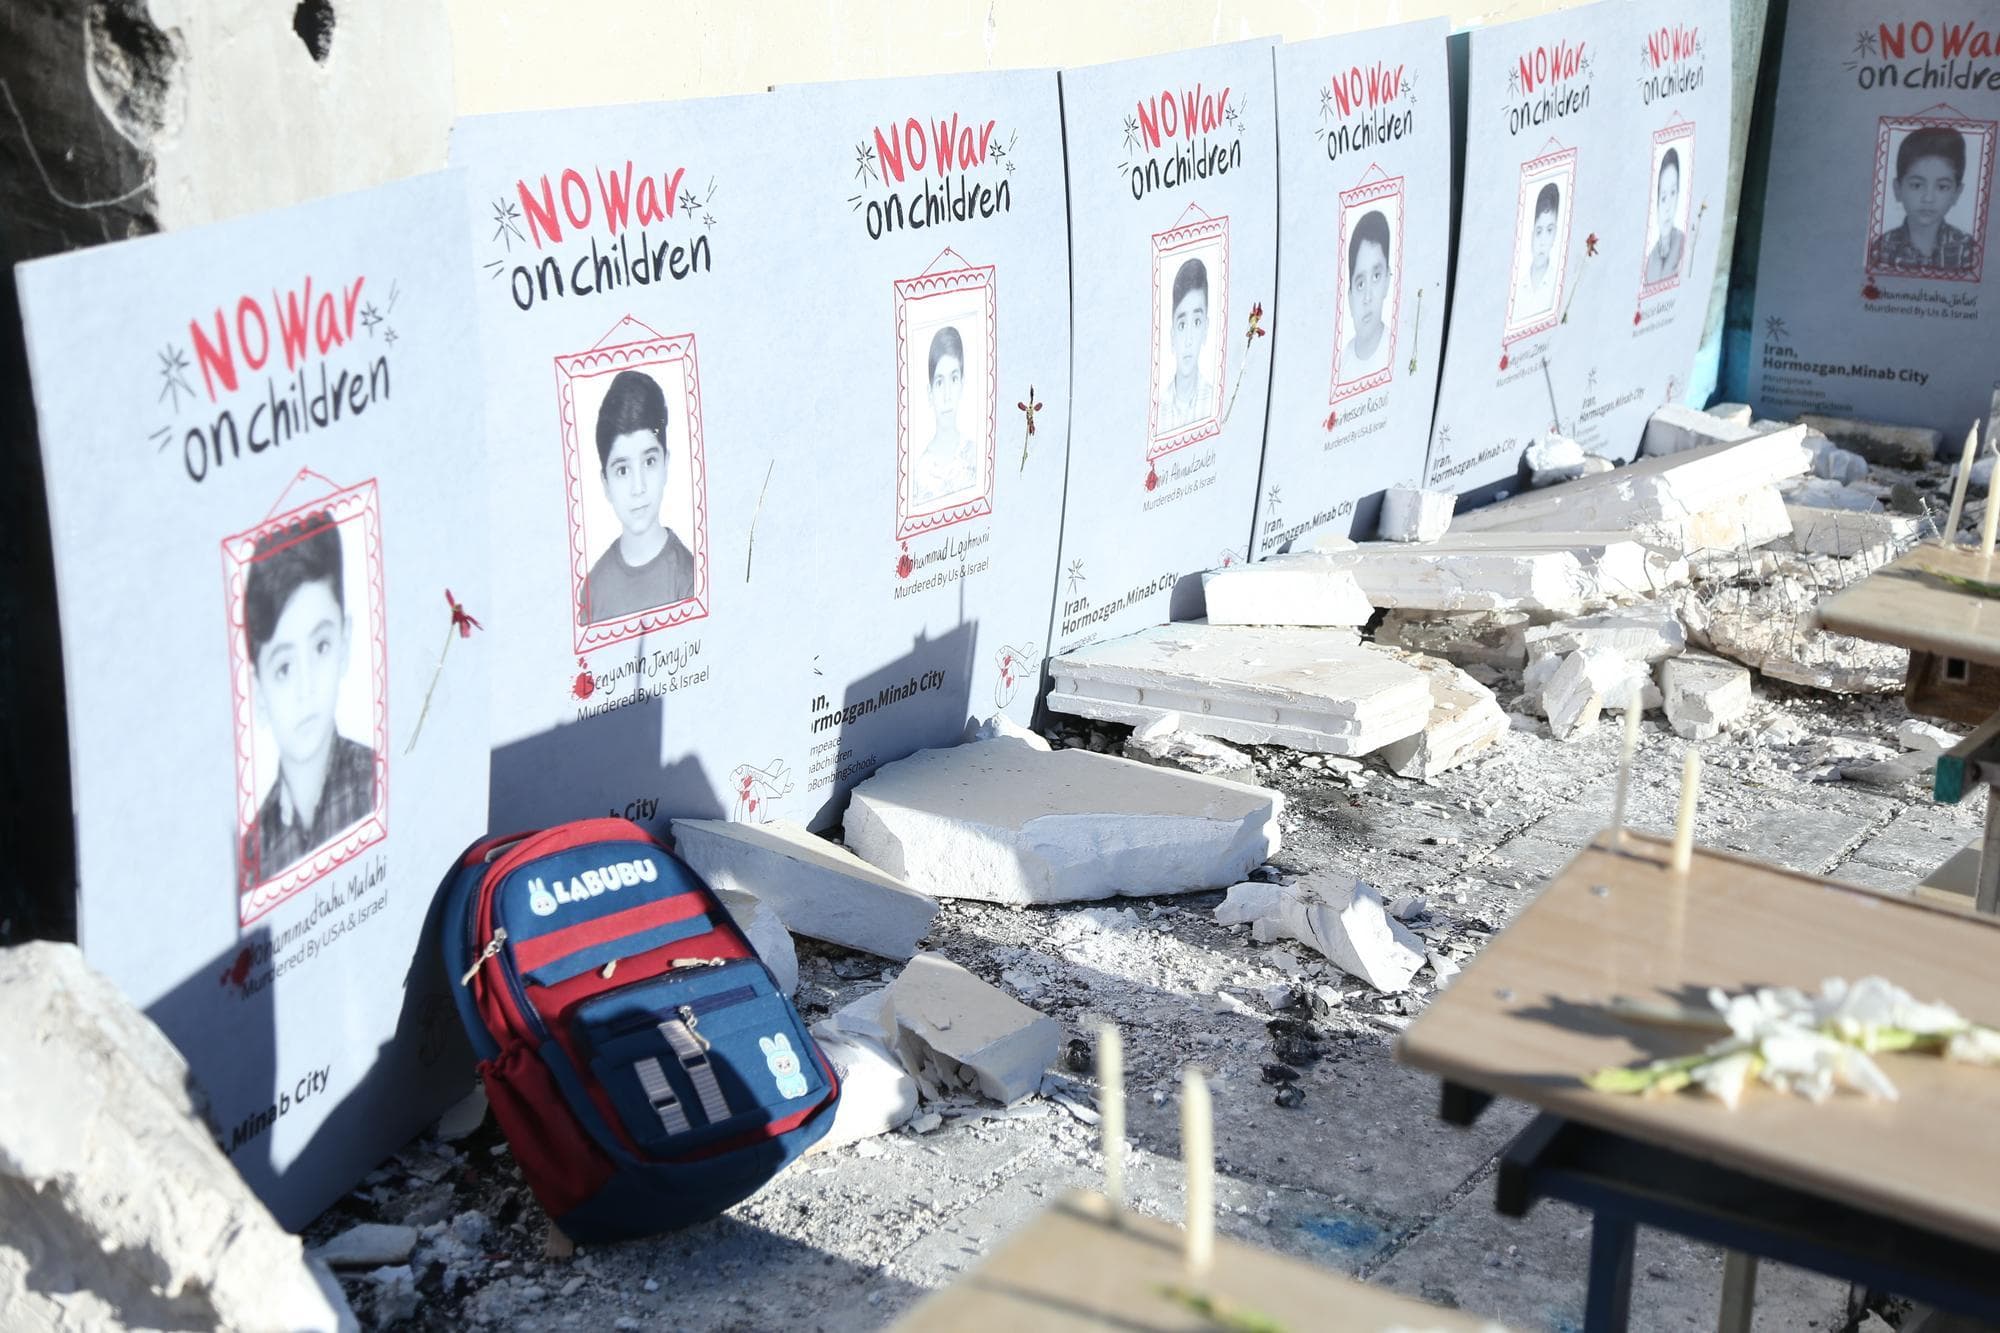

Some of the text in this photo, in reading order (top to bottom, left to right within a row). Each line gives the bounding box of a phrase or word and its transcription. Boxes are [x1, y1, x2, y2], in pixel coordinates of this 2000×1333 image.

[1648, 22, 1698, 72] NO War
[1879, 20, 1934, 60] NO
[1332, 60, 1404, 121] NO War
[1519, 38, 1586, 97] NO War
[1643, 62, 1704, 106] on children
[1858, 64, 1898, 90] on
[1137, 82, 1230, 153] NO War
[1328, 107, 1412, 161] on children
[1510, 83, 1590, 136] on children
[874, 112, 995, 187] NO War
[1131, 137, 1240, 200] on children
[516, 160, 686, 250] NO War
[866, 174, 1010, 240] on children
[512, 231, 711, 311] on children
[1864, 303, 1912, 314] Murdered
[1915, 306, 1925, 318] By
[1941, 309, 1949, 318] &
[1951, 309, 1978, 320] Israel
[190, 276, 365, 402] NO War
[1764, 344, 1798, 358] Iran,
[1899, 368, 1929, 387] City
[185, 356, 390, 482] on children
[1142, 491, 1176, 513] Murdered
[1264, 518, 1284, 536] Iran,
[1337, 500, 1353, 517] City
[894, 556, 989, 600] Murdered By Us & Israel
[1158, 572, 1179, 591] City
[1063, 596, 1090, 618] Iran,
[577, 665, 709, 722] Murdered By Us & Israel
[811, 670, 945, 734] rmozgan,Minab City
[625, 798, 659, 822] City
[553, 858, 658, 904] LABUBU
[241, 889, 388, 1000] Murdered By USA & Israel
[295, 1065, 330, 1104] City
